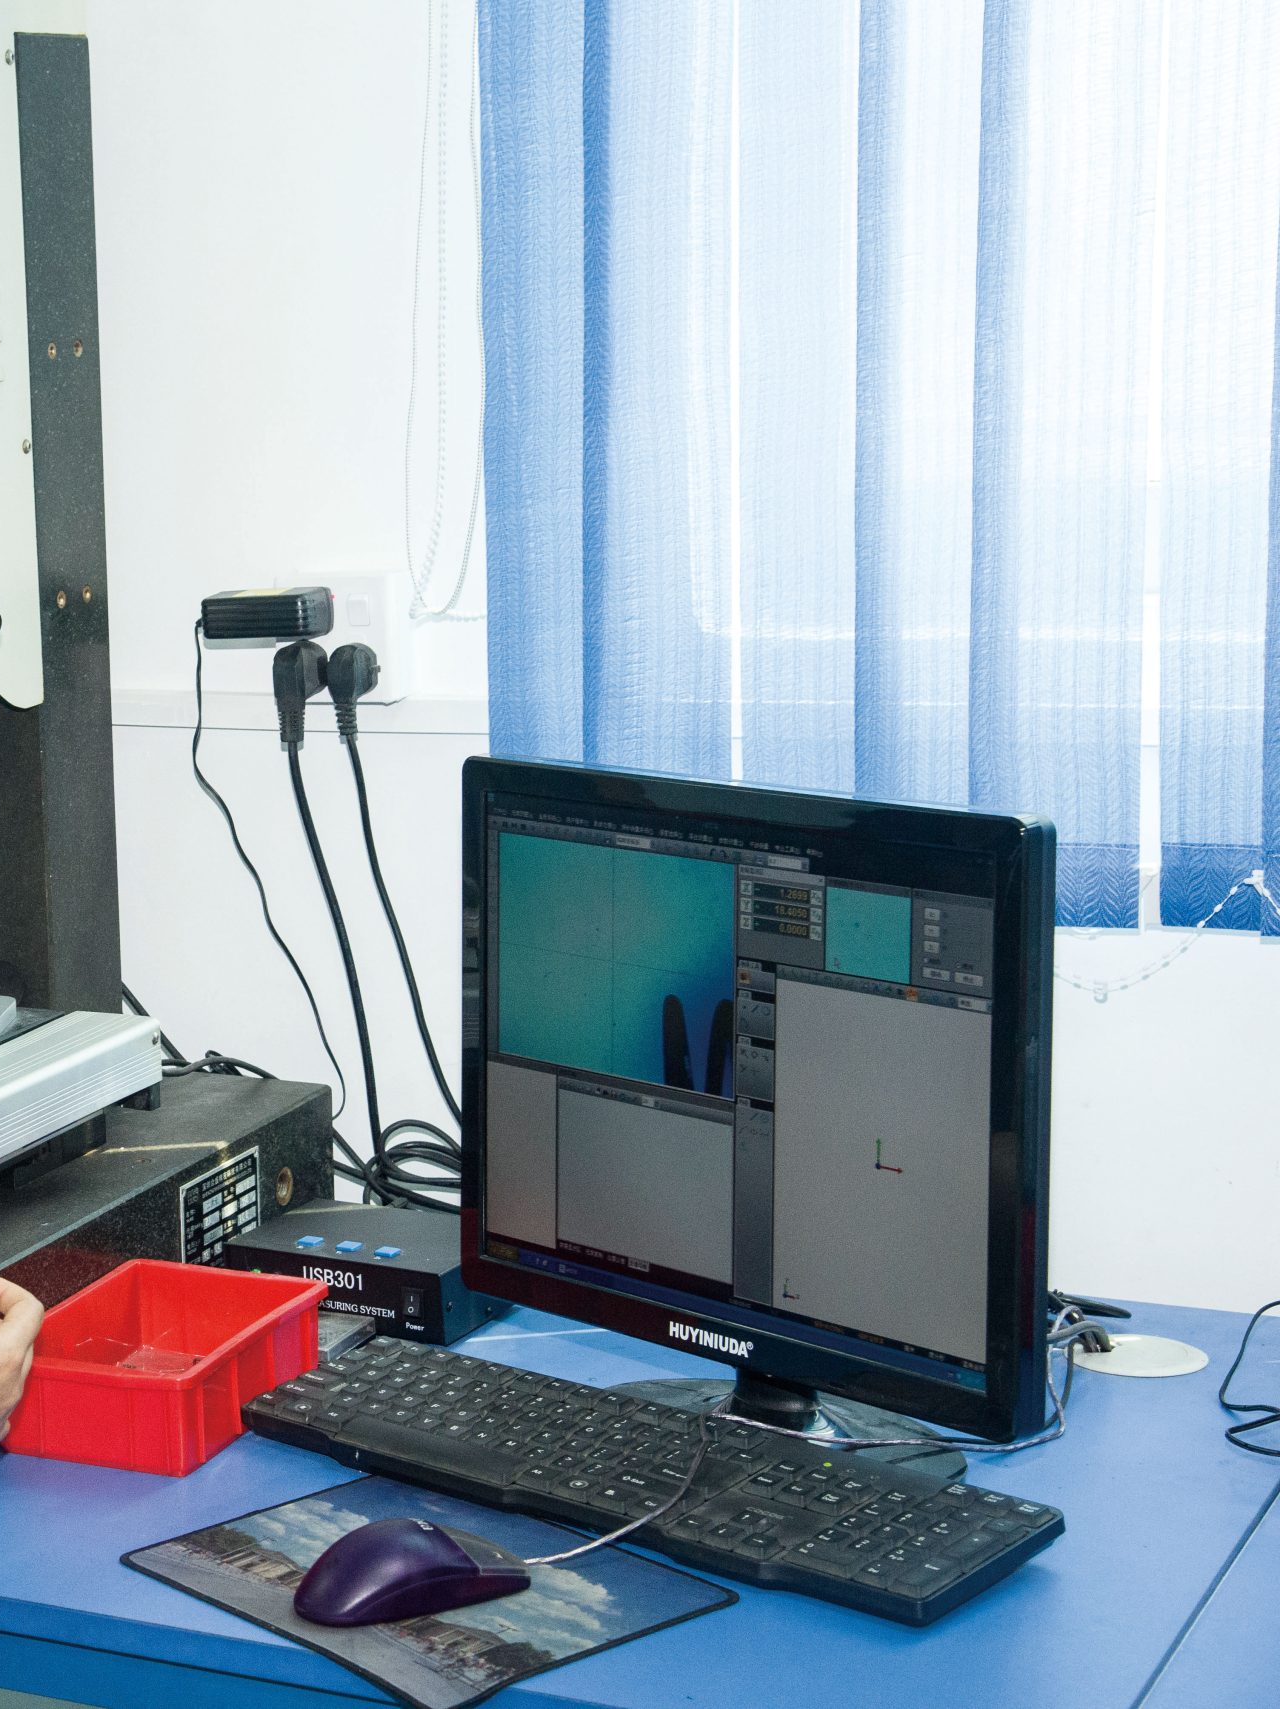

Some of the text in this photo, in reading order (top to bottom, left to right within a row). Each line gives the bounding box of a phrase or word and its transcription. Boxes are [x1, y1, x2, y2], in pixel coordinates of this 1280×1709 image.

[303, 1266, 363, 1291] USB301
[318, 1300, 395, 1319] ASURING SYSTEM
[405, 1322, 425, 1332] Power
